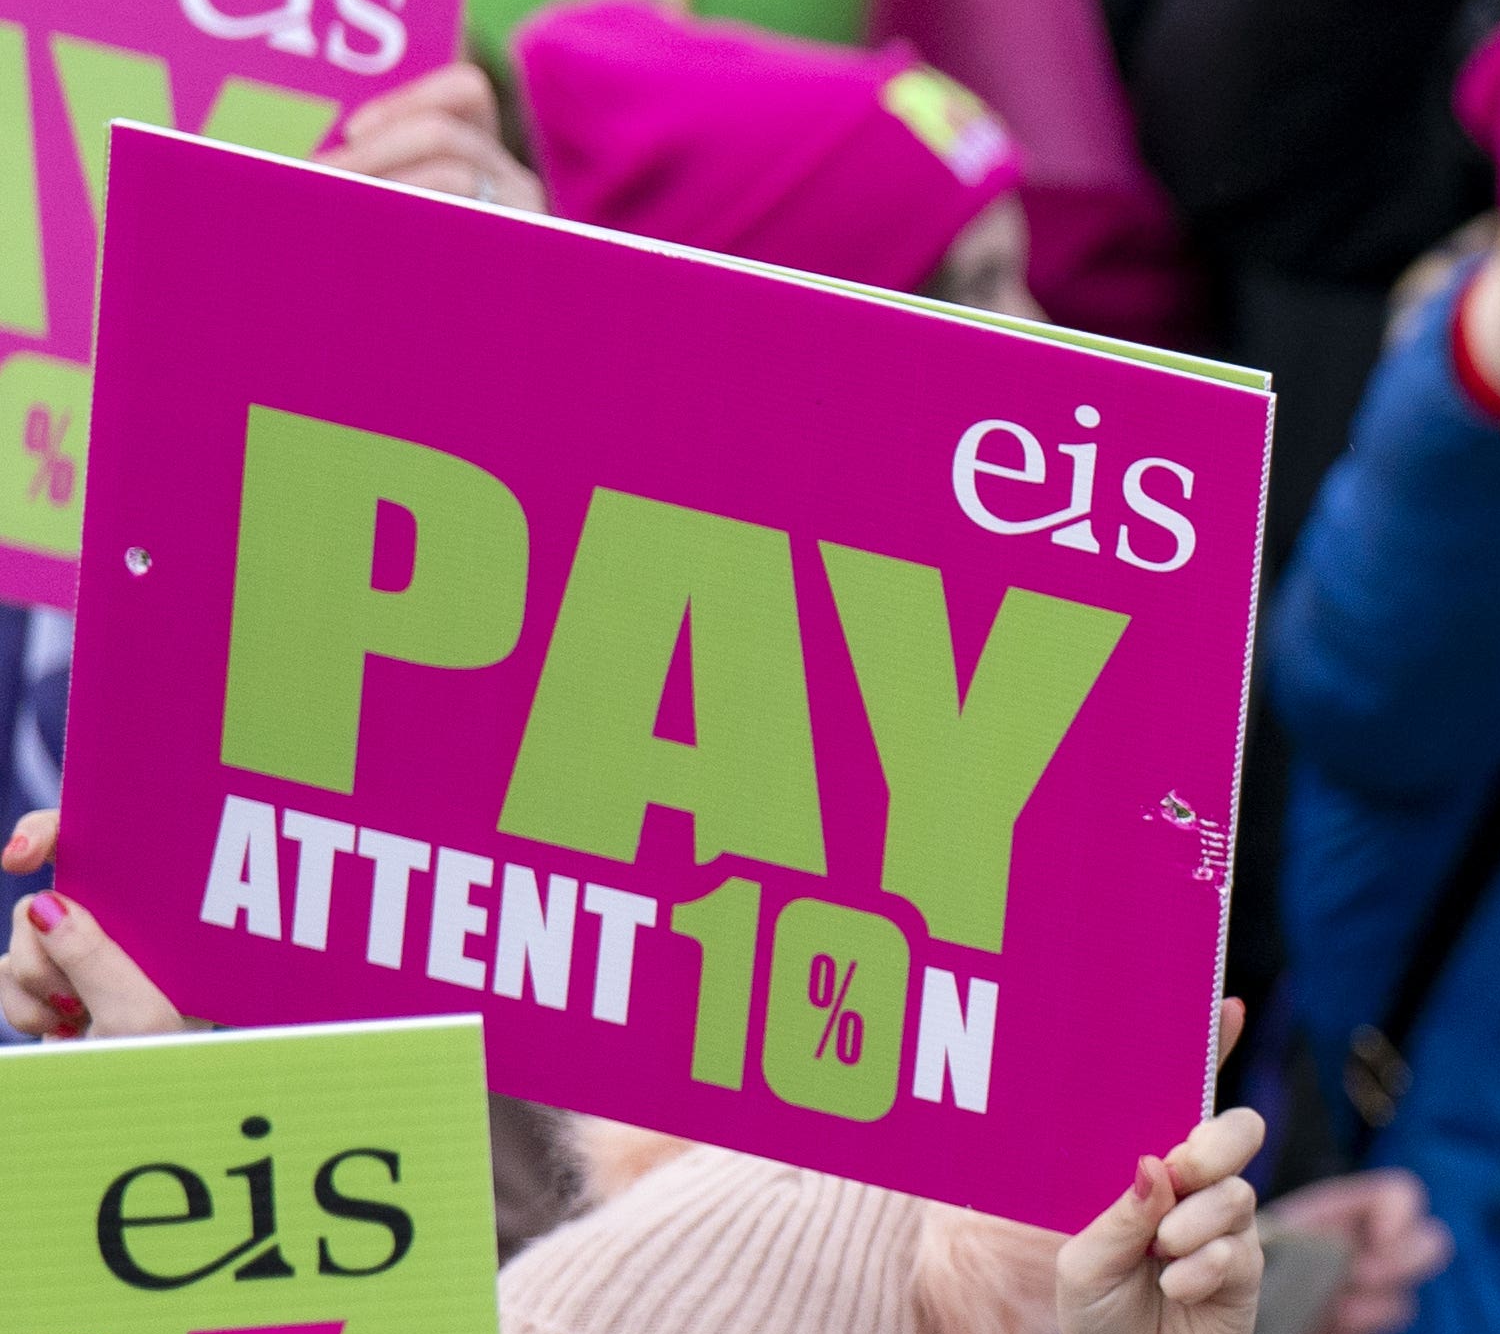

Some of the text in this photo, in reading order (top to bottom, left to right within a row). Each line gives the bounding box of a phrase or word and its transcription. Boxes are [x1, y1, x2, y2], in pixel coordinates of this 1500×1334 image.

[952, 404, 1197, 572] eis
[220, 403, 1132, 955] PAY
[97, 1115, 415, 1292] eis
